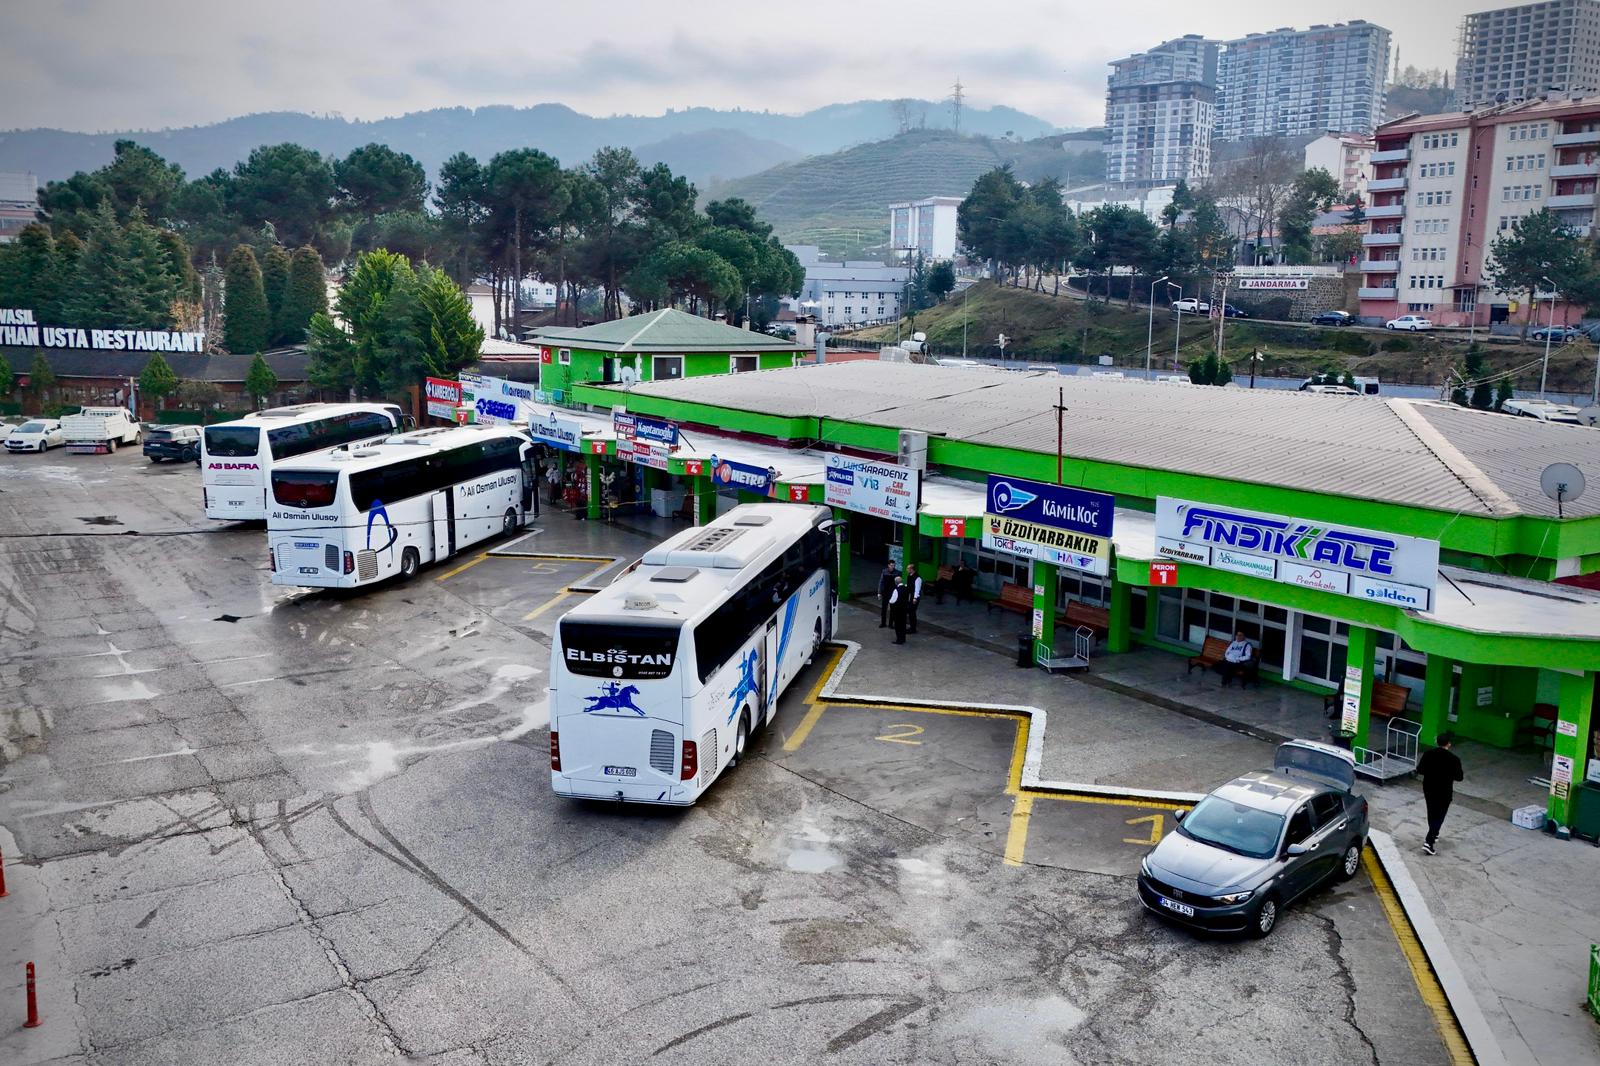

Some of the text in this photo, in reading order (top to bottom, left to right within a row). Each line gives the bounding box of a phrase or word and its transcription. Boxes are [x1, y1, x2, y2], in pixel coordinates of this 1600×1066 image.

[43, 327, 90, 349] USTA
[92, 329, 205, 352] RESTAURANT
[538, 424, 557, 439] Osman
[557, 428, 576, 444] Ulusoy
[691, 466, 698, 474] 4
[731, 470, 767, 487] METRO
[466, 474, 517, 497] Ali Osman Ulusoy
[796, 491, 803, 500] 3
[282, 512, 311, 520] Osman
[312, 513, 339, 522] Ulusoy
[949, 525, 958, 536] 2
[1003, 520, 1099, 555] ÖZDİYARBAKIR
[1159, 572, 1167, 584] 1
[875, 723, 924, 745] 2
